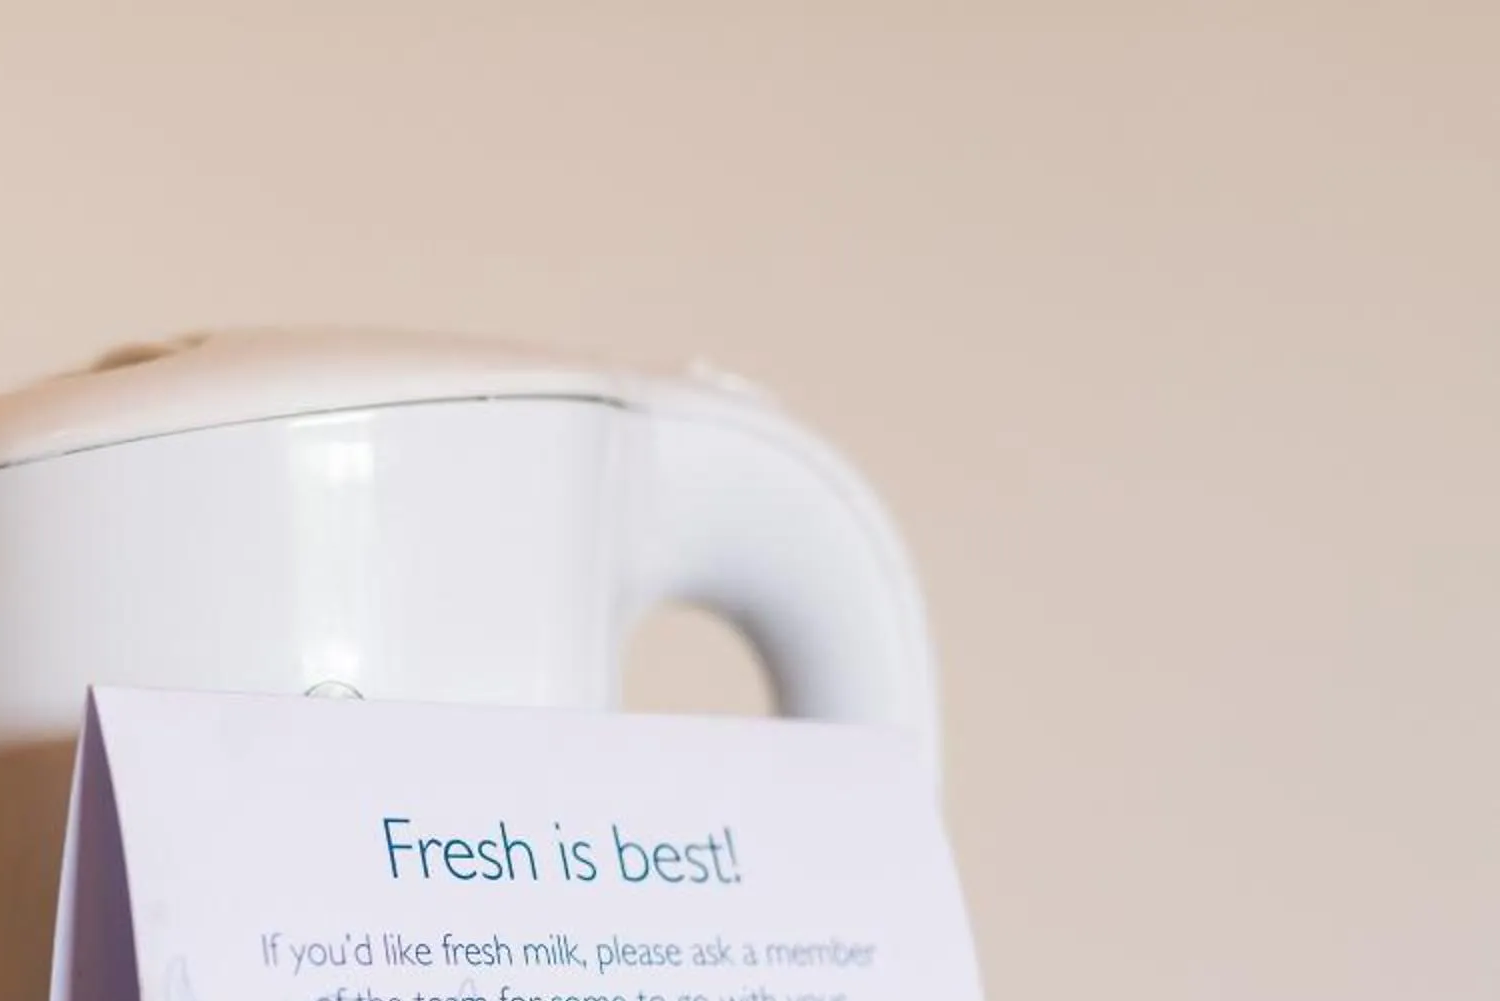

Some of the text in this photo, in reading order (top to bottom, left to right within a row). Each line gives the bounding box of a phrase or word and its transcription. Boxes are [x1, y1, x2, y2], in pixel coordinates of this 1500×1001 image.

[383, 818, 741, 883] Fresh is best!
[261, 933, 876, 976] If you'd like fresh milk, please ask a member
